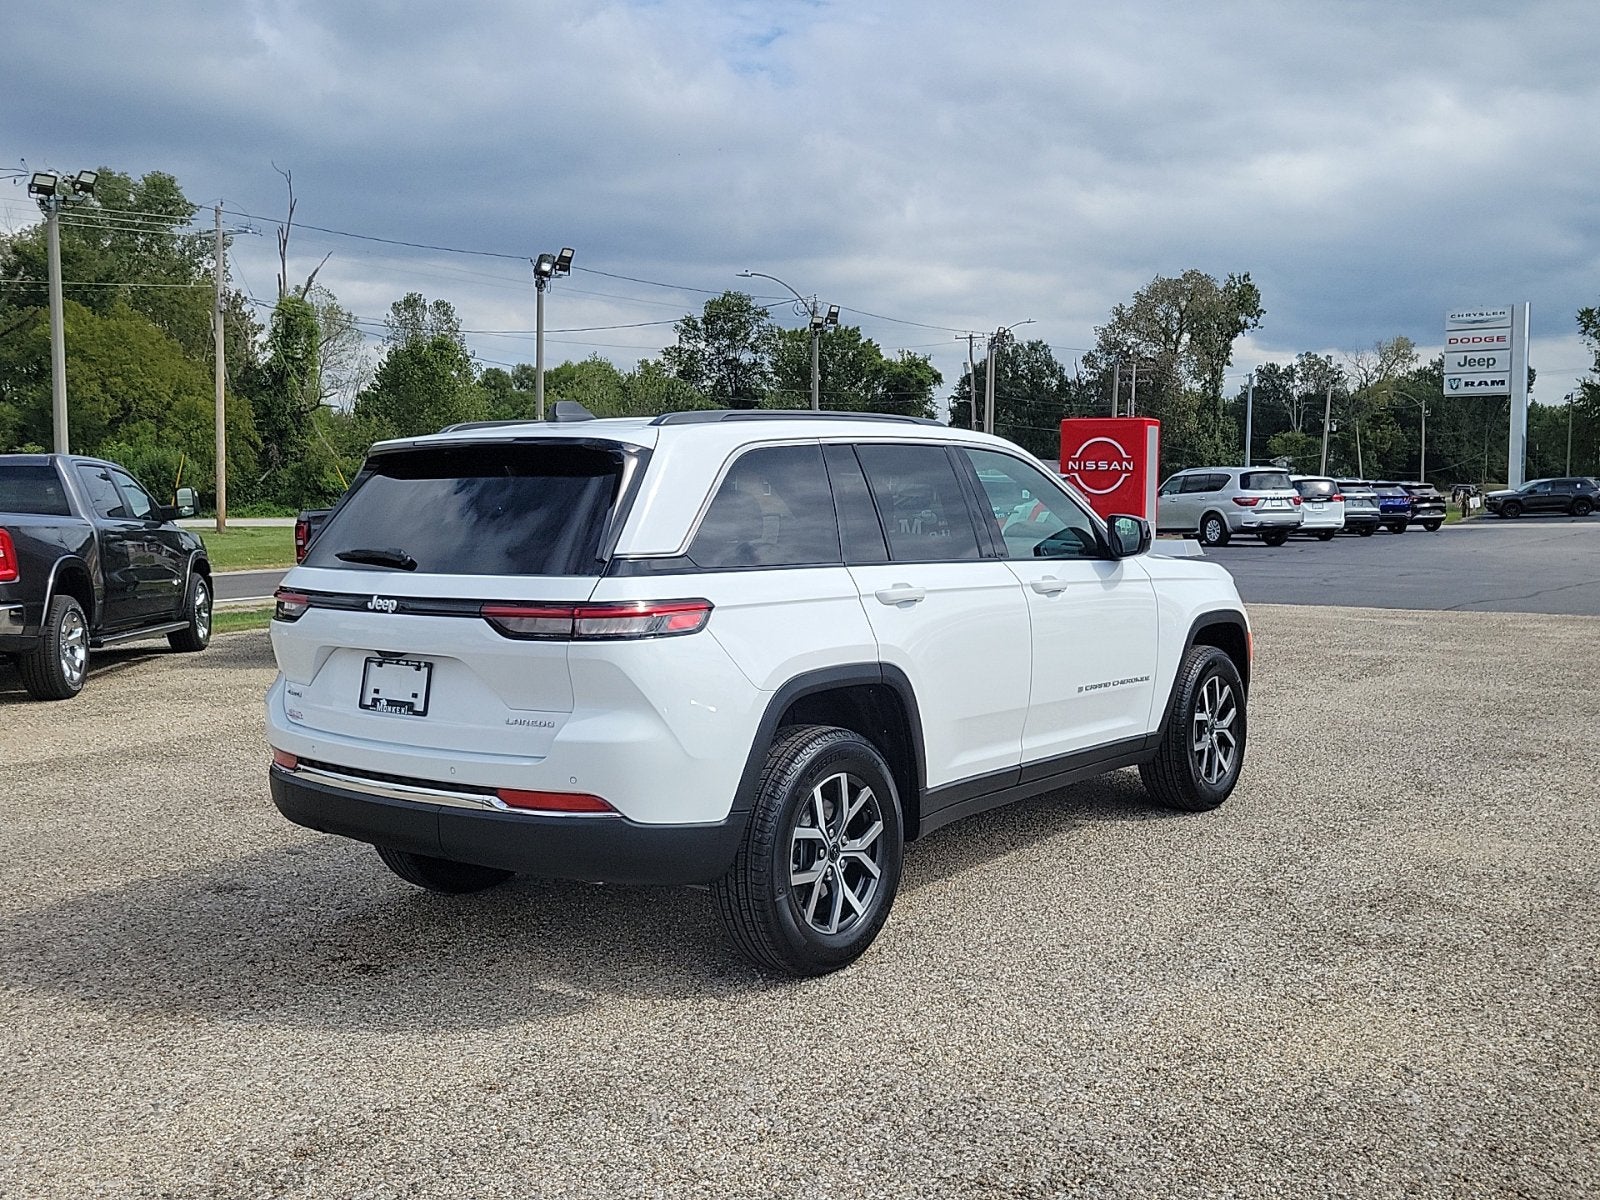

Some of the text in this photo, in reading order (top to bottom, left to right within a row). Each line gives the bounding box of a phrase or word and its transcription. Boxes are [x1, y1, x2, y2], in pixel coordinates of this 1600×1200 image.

[1450, 311, 1506, 319] CHRYSLER
[1448, 335, 1507, 345] DODGE
[1457, 355, 1497, 369] Jeep
[1464, 379, 1506, 388] RAM
[1068, 461, 1134, 471] NISSAN
[367, 595, 398, 614] Jeep
[1084, 681, 1111, 692] GRAND
[505, 717, 555, 729] LAREDO
